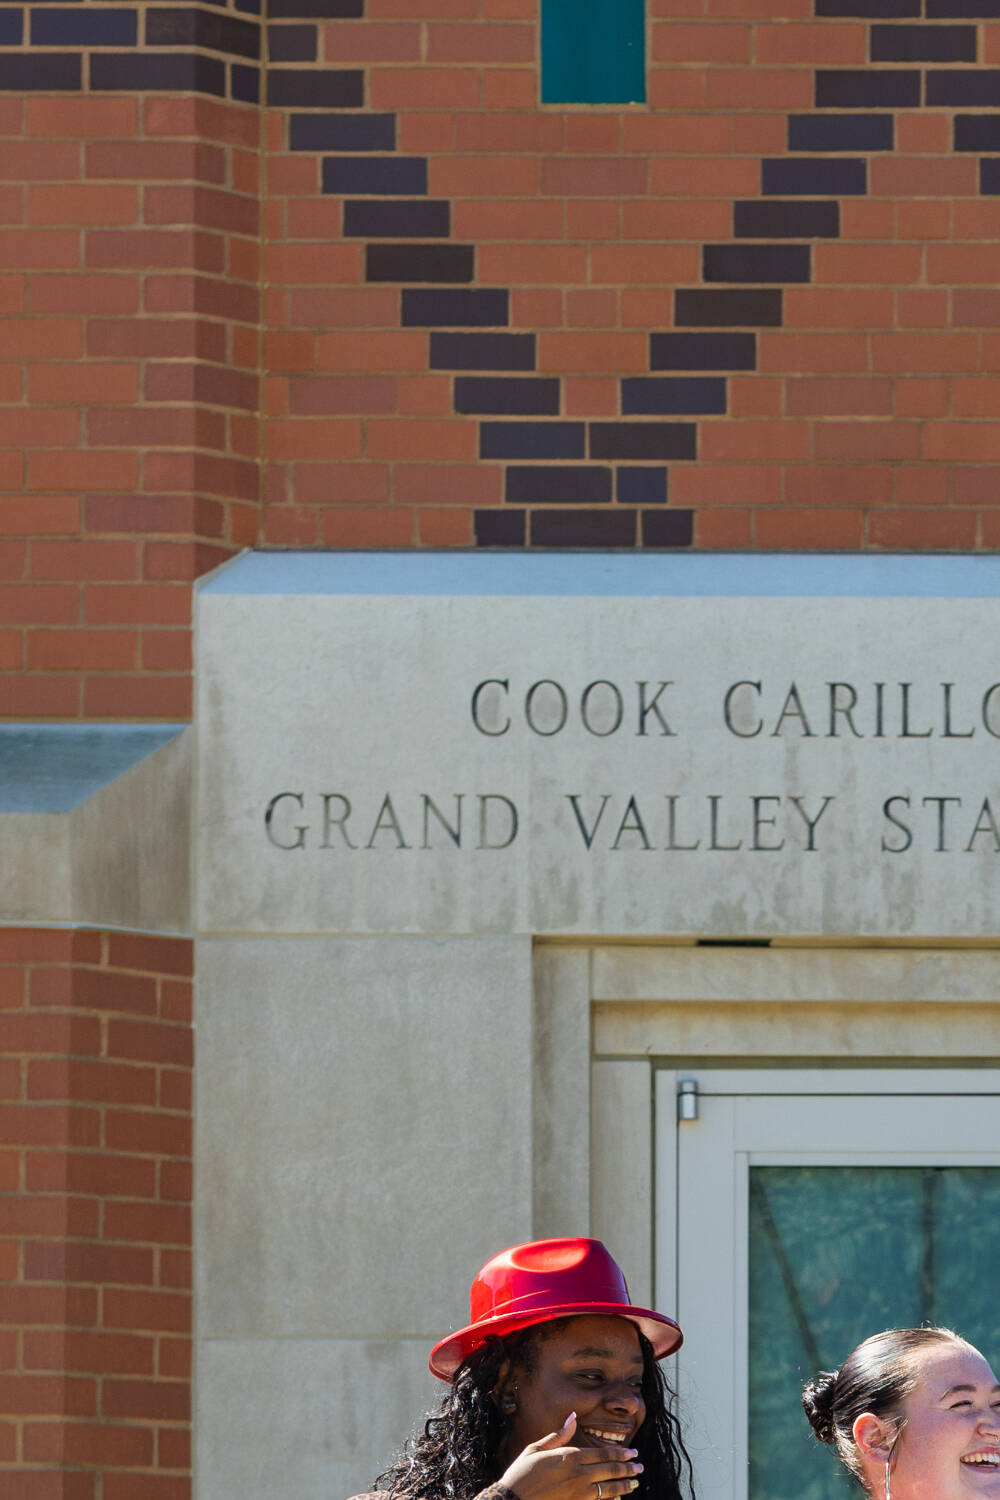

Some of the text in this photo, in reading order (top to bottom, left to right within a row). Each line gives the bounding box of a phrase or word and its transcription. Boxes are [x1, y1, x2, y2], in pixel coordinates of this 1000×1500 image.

[471, 679, 678, 737] COOK
[264, 791, 519, 851] GRAND
[565, 795, 836, 852] VALLEY
